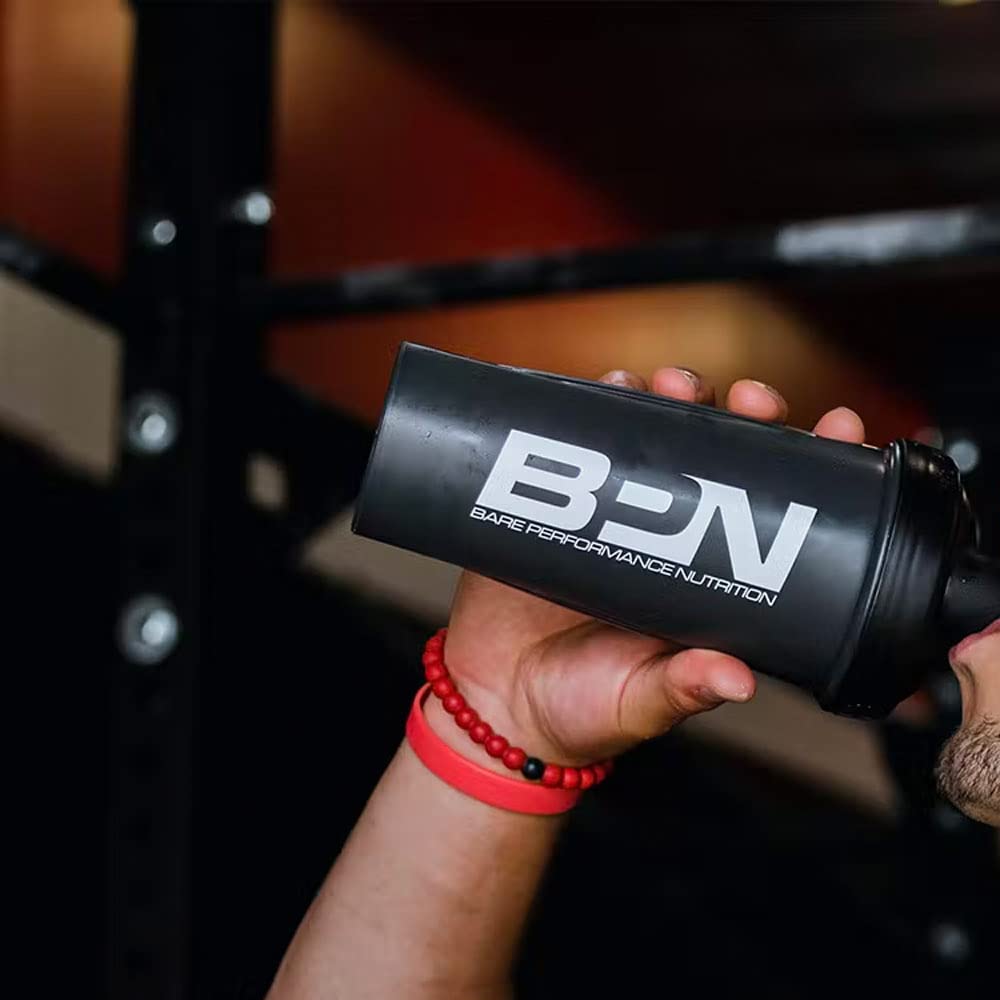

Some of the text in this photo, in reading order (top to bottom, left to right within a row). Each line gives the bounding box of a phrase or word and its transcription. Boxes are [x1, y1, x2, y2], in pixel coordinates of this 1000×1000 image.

[469, 506, 778, 607] BARE PERFORMANCE NUTRITION
[475, 429, 817, 592] BPN
